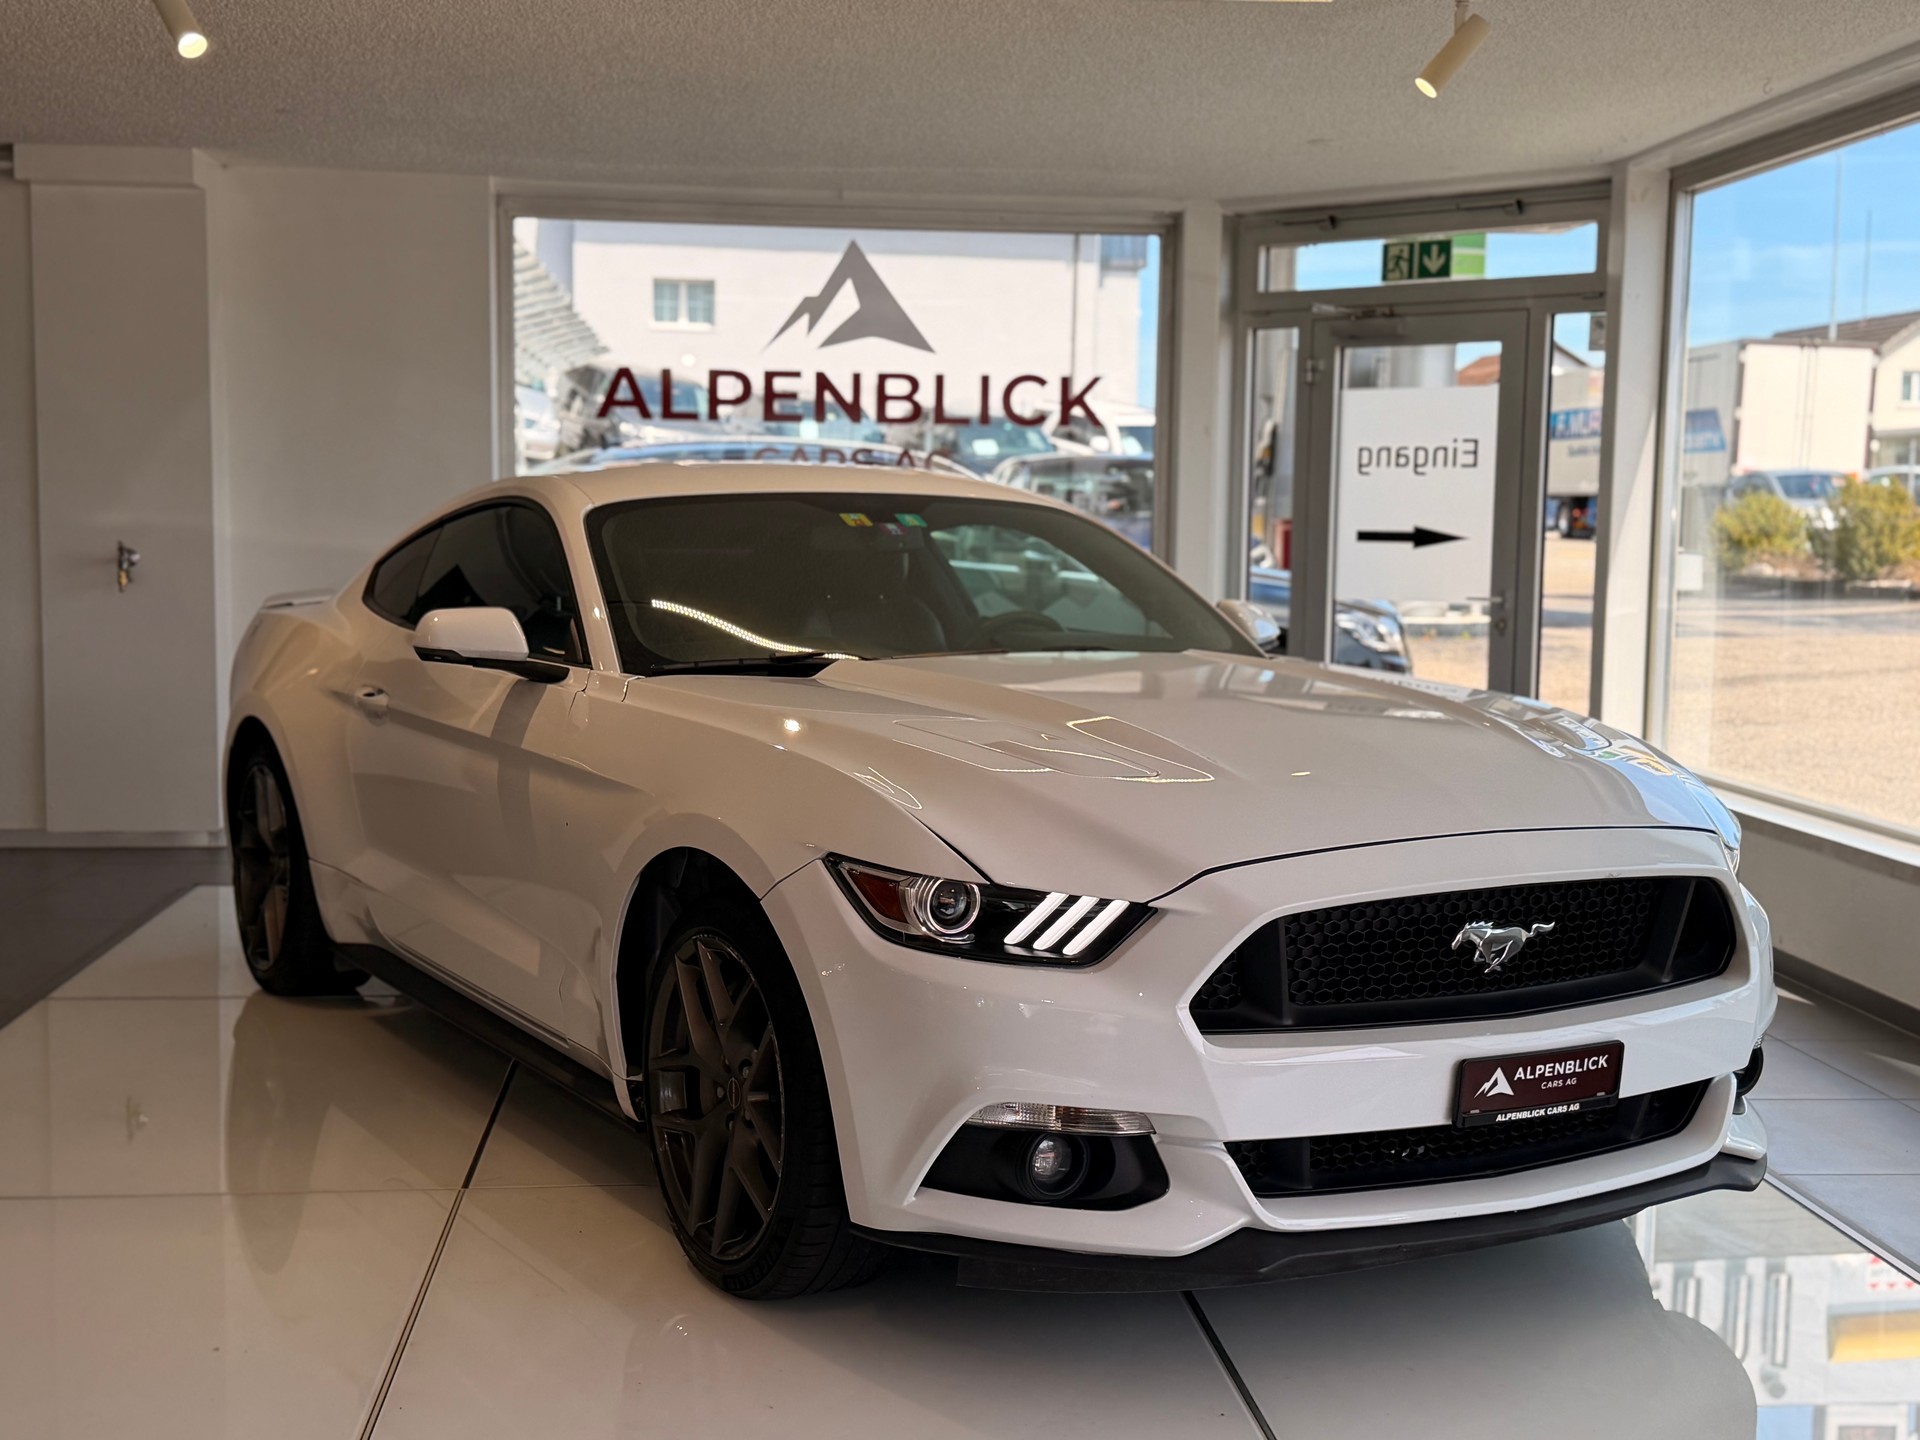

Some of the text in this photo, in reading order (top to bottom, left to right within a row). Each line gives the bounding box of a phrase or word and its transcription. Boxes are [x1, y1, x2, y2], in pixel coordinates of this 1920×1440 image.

[596, 367, 1103, 427] ALPENBLICK
[1513, 1054, 1609, 1081] ALPENBLICK
[1540, 1077, 1578, 1090] CARS AG
[1495, 1102, 1580, 1122] ALPENBLICK CARS AG
